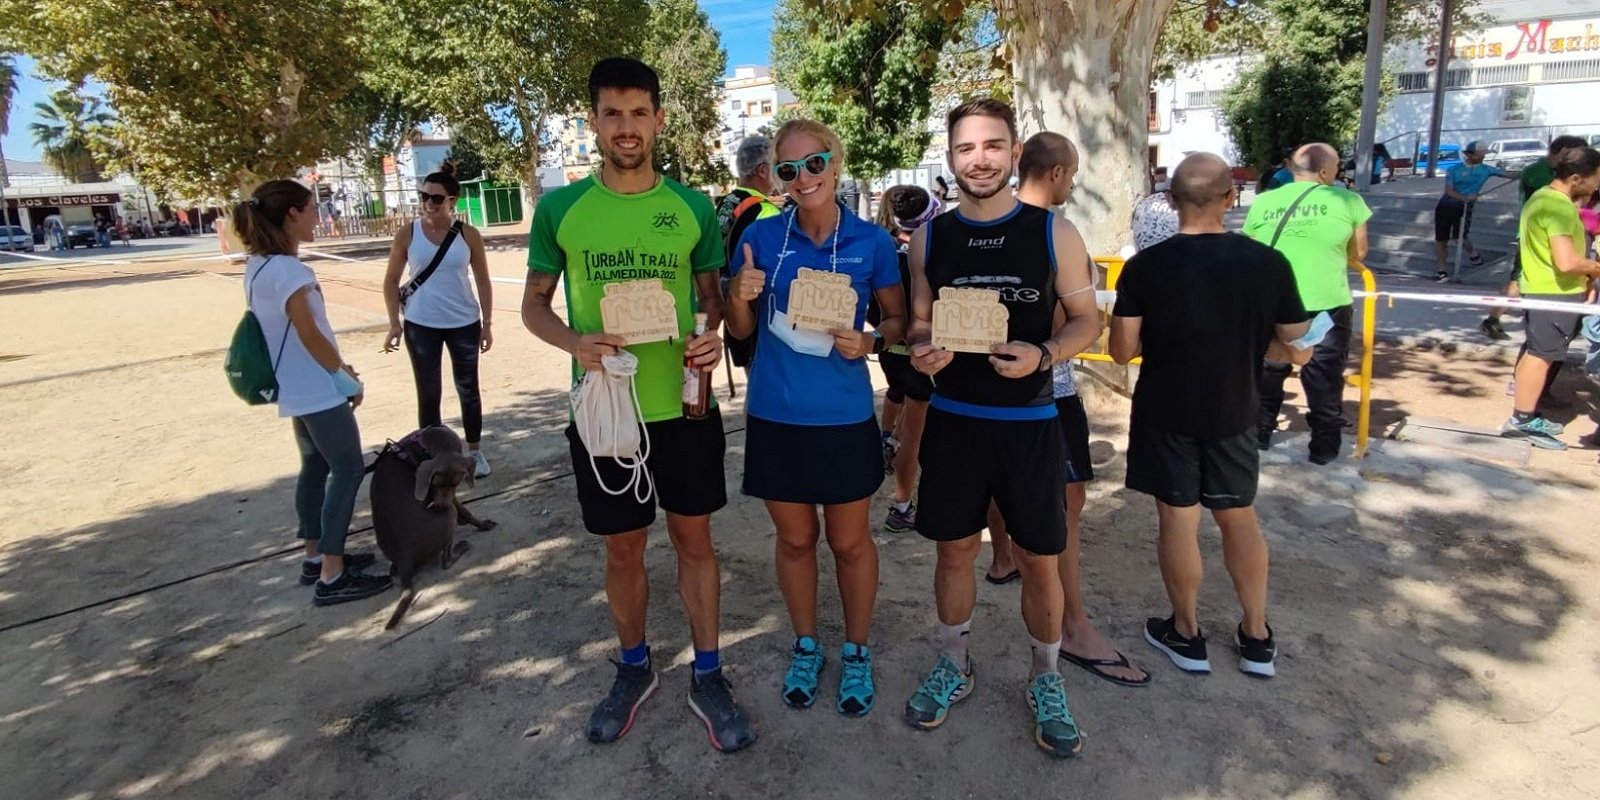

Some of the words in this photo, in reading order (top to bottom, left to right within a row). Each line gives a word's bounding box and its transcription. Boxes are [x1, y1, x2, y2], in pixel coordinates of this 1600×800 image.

[17, 197, 42, 207] Los
[49, 194, 109, 206] Claveles
[968, 235, 1006, 247] land
[593, 268, 660, 281] ALMEDINA
